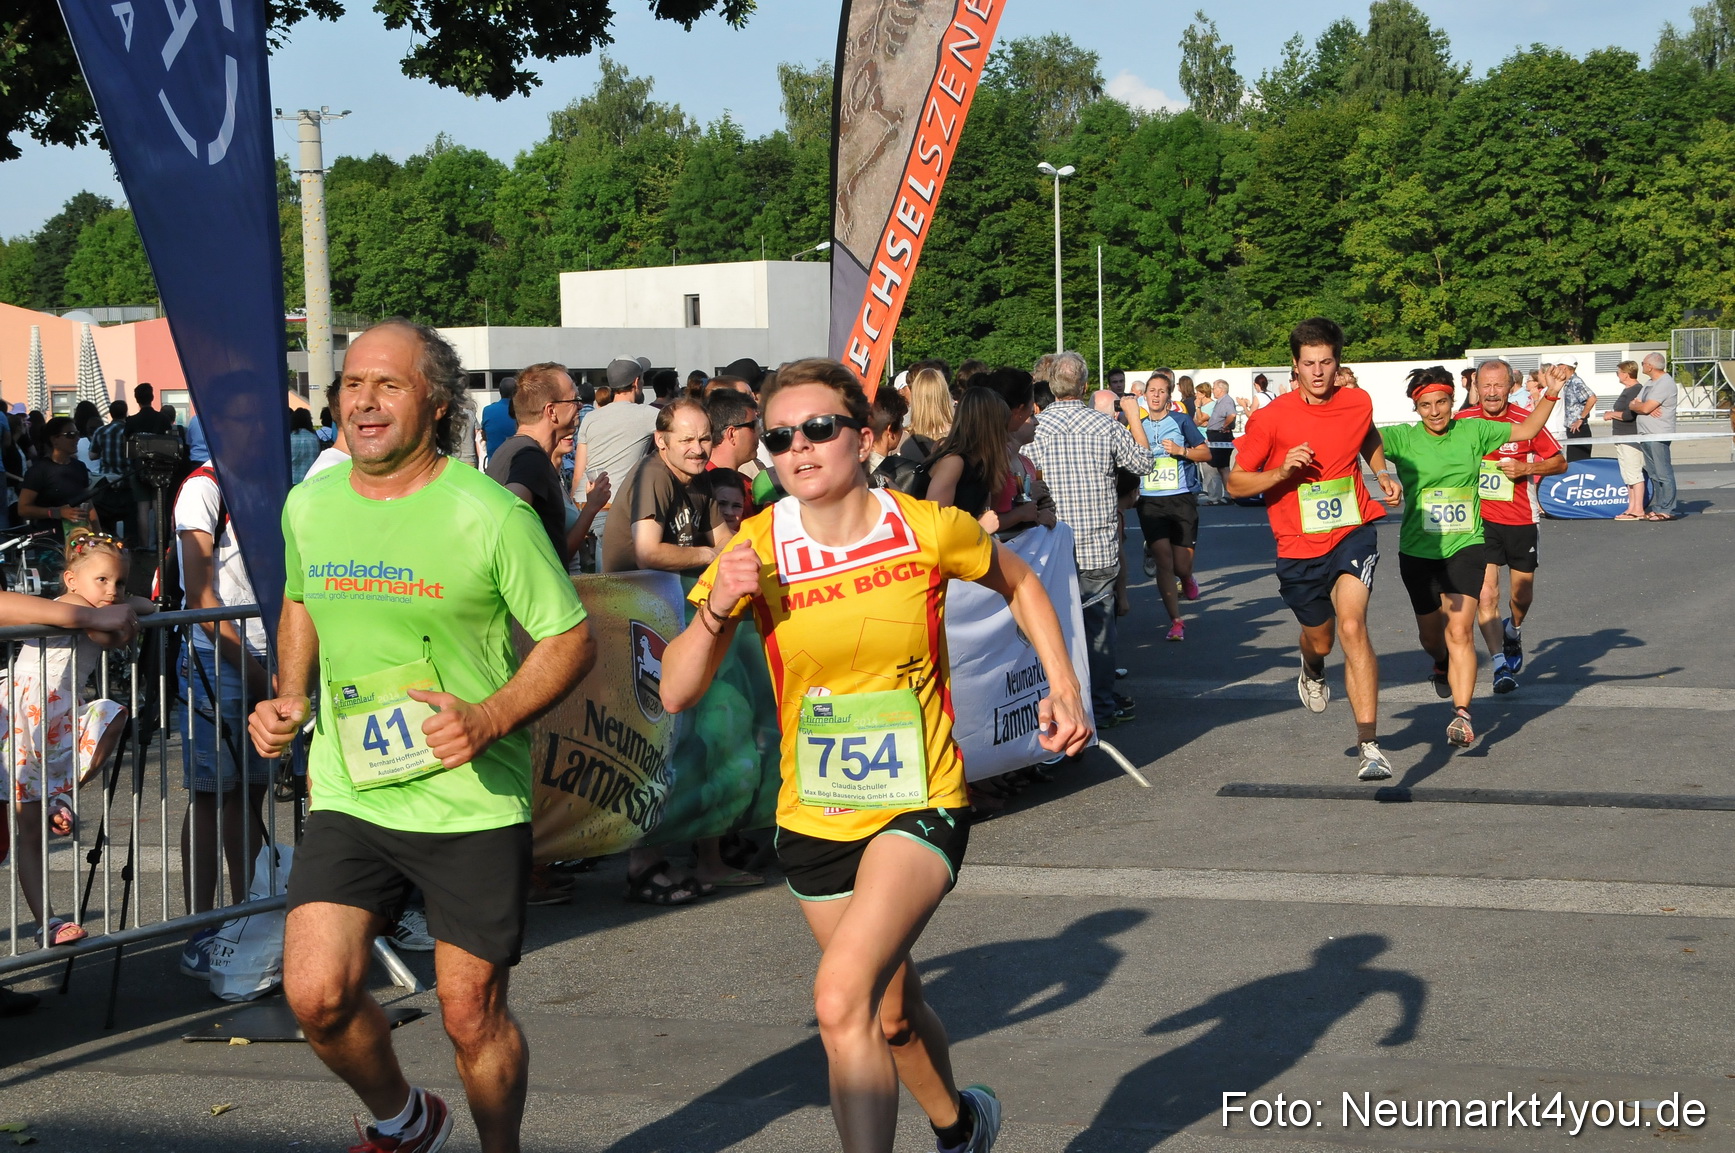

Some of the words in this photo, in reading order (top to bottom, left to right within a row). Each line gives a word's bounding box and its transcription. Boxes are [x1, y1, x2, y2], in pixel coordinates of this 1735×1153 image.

[1479, 474, 1500, 490] 20
[1566, 484, 1629, 500] Fische
[1316, 498, 1342, 520] 89
[1573, 498, 1629, 506] AUTOMOBIL
[1430, 504, 1466, 523] 566
[308, 559, 414, 581] autoladen
[324, 577, 444, 599] neumarkt
[780, 583, 846, 613] MAX
[853, 562, 925, 594] BÖGL
[1006, 657, 1048, 698] Neumarkt
[806, 714, 852, 724] firmenlauf
[993, 690, 1042, 746] Lamms
[362, 707, 414, 756] 41
[368, 756, 396, 769] Bernhard
[396, 748, 430, 763] Hoffmann
[405, 759, 425, 769] GmbH
[808, 733, 904, 781] 754
[832, 782, 857, 790] Claudia
[857, 783, 888, 791] Schuller
[833, 791, 865, 800] Bauservice
